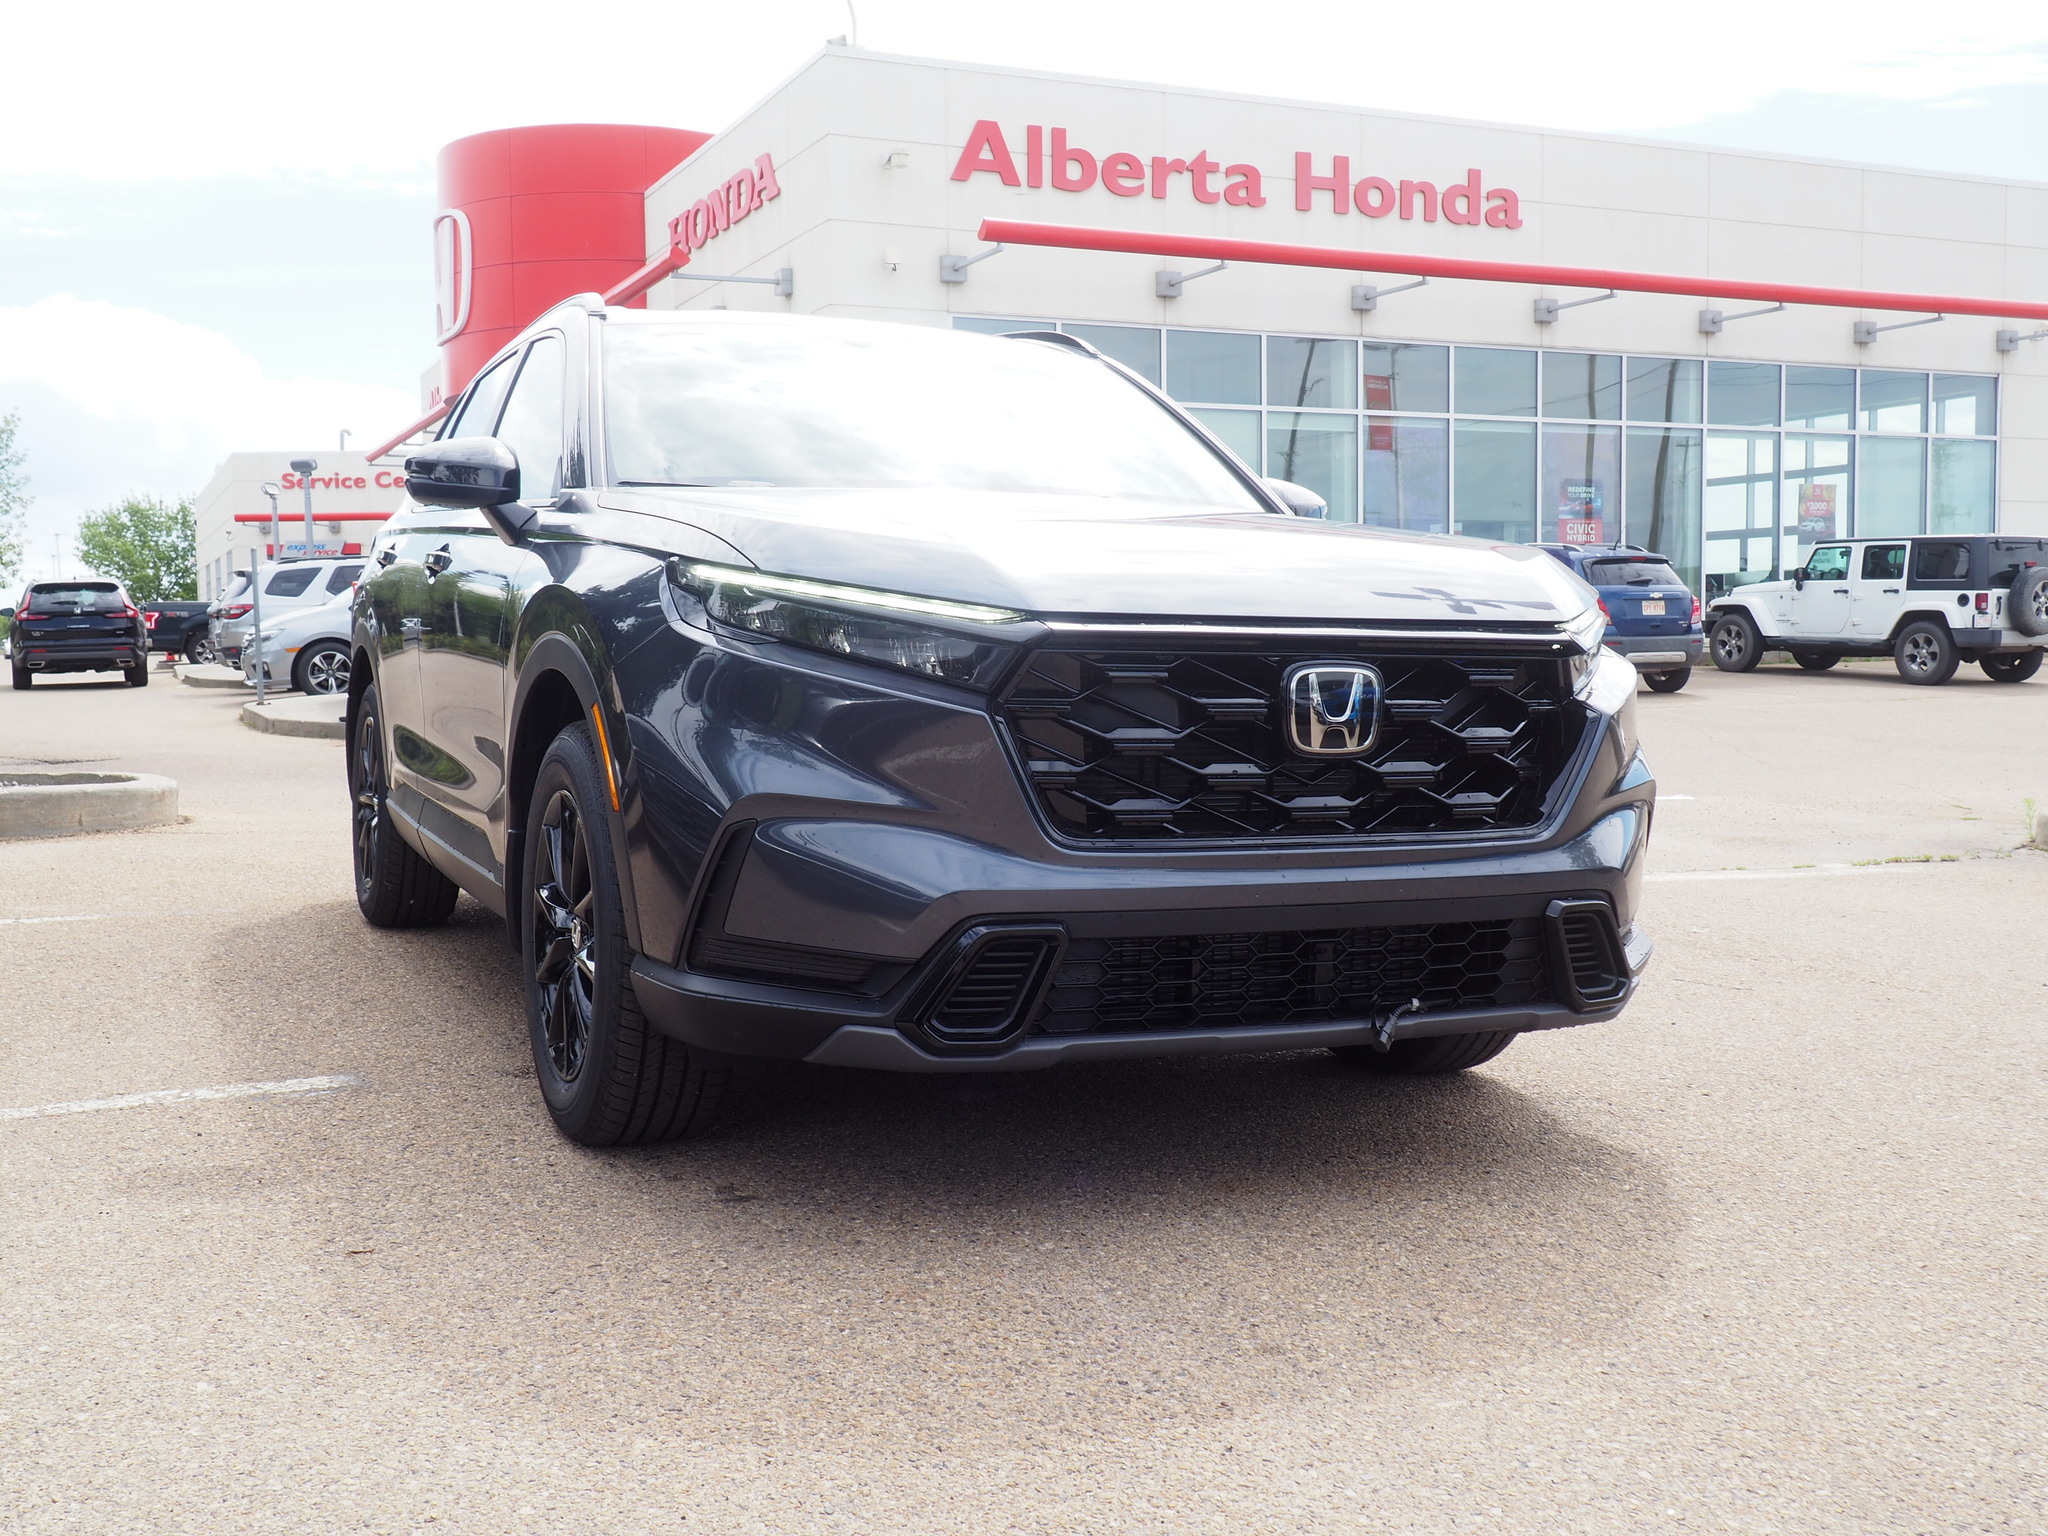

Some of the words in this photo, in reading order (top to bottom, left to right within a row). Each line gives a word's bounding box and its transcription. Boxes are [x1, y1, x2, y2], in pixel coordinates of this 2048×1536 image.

[950, 119, 1266, 207] Alberta
[1294, 150, 1523, 230] Honda
[667, 152, 782, 256] HONDA
[281, 472, 367, 490] Service
[1566, 523, 1596, 534] CIVIC
[1566, 534, 1596, 542] HYBRID
